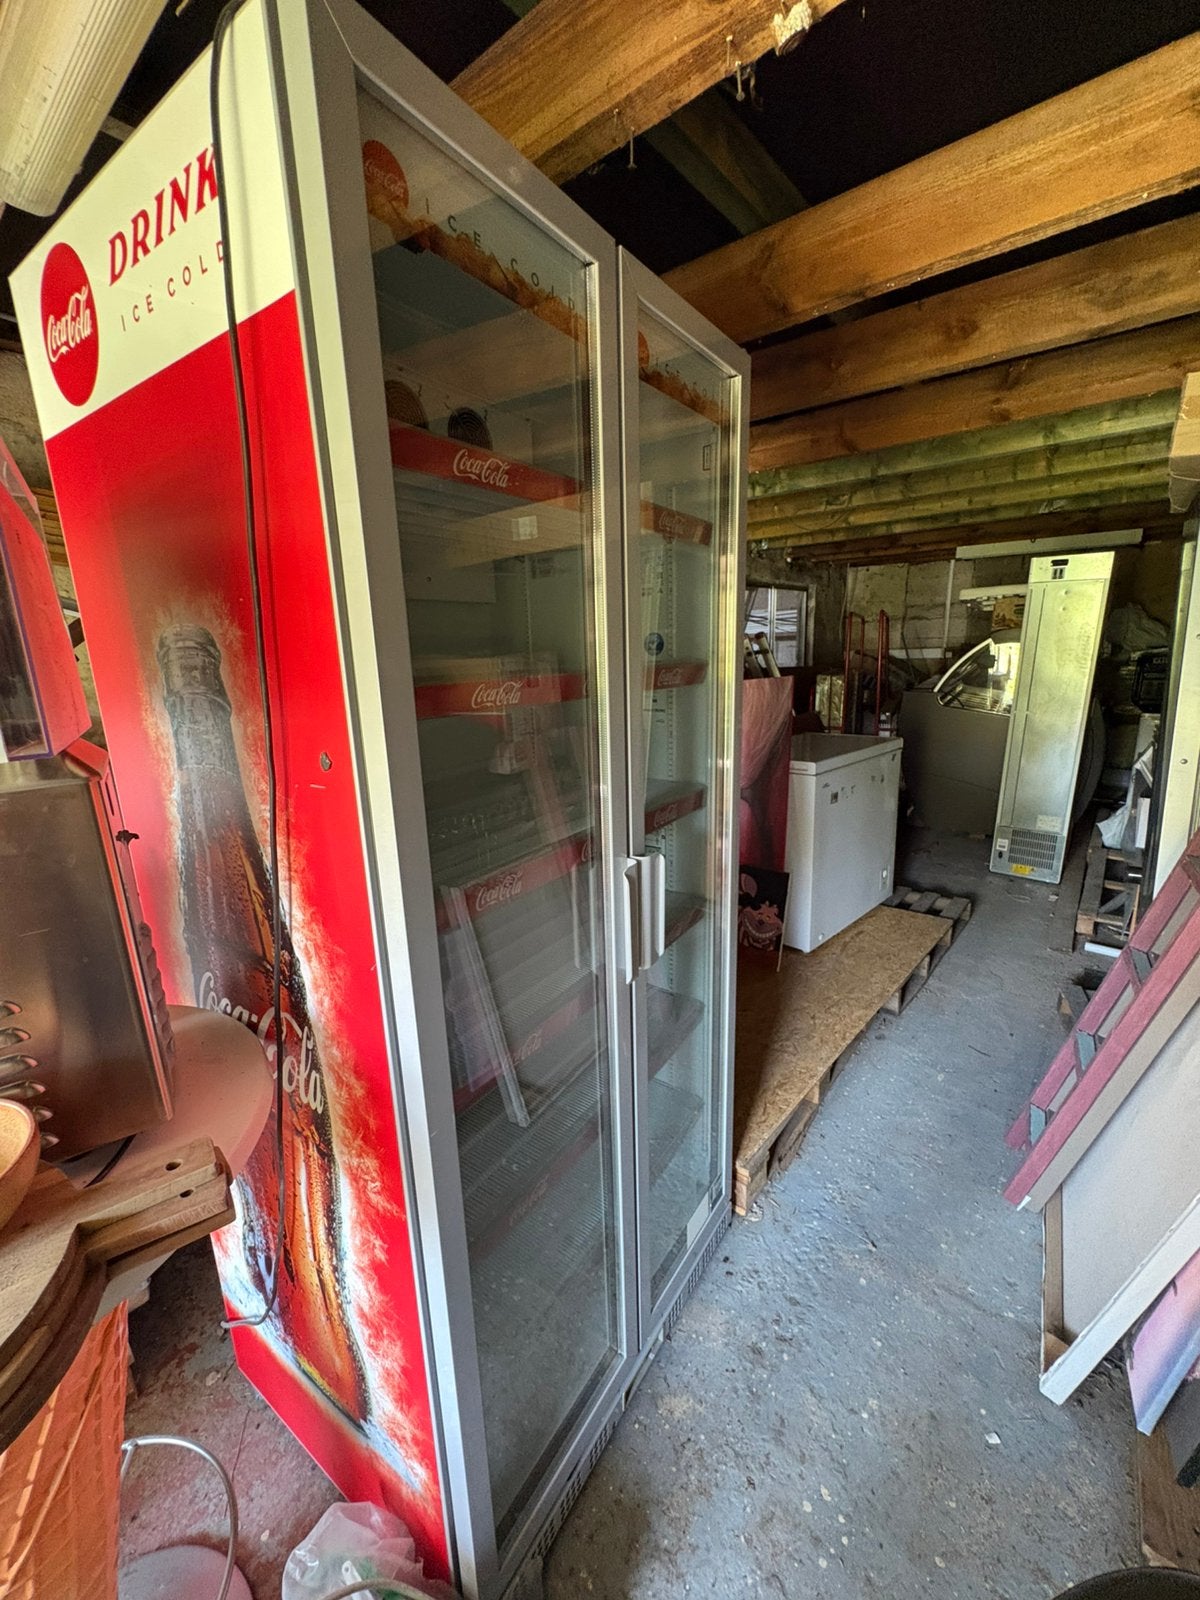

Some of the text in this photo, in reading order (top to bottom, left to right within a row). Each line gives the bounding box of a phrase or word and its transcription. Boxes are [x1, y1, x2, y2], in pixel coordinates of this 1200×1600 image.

[109, 143, 218, 287] DRINK
[46, 284, 93, 363] Coca-Cola
[121, 294, 154, 332] ICE
[453, 449, 510, 488] Coca-Cola
[471, 681, 524, 709] Coca-Cola
